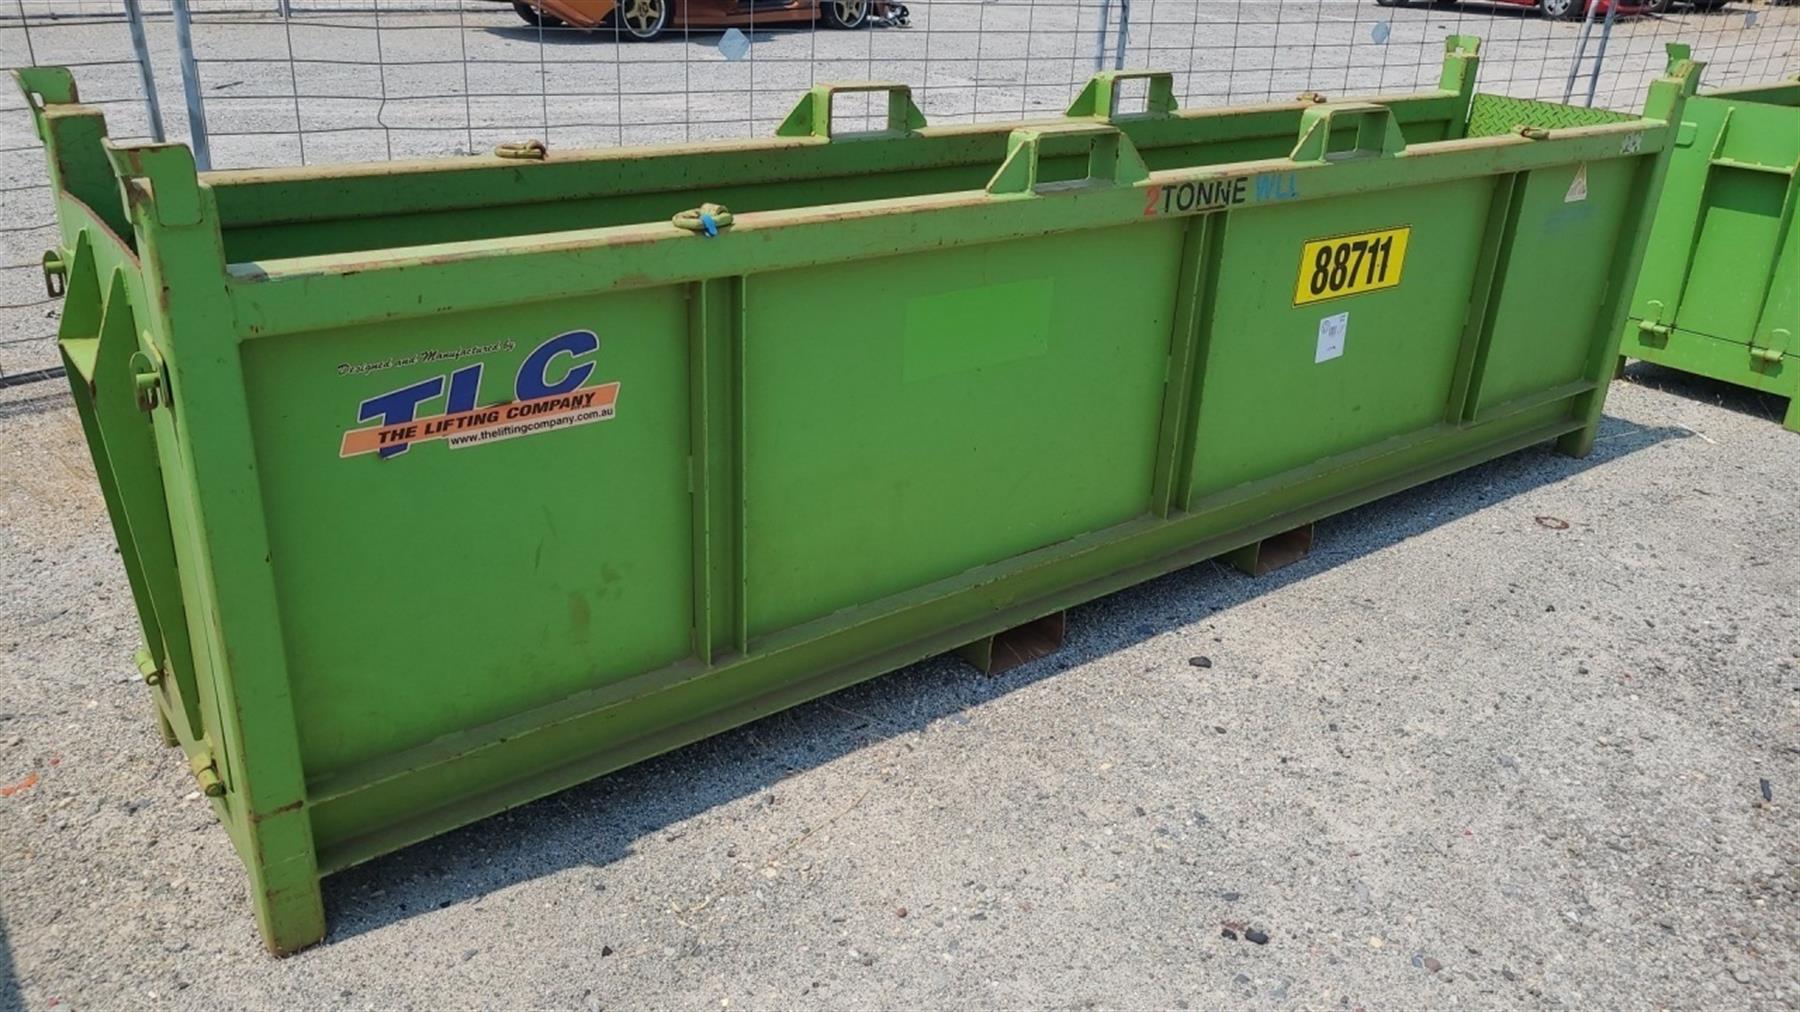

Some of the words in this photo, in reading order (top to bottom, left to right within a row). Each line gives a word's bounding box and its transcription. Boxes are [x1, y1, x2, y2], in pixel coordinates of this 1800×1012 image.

[1311, 235, 1393, 295] 88711
[337, 358, 393, 376] Designed
[395, 356, 417, 368] and
[421, 342, 501, 361] Manufactured
[358, 329, 599, 459] TLC
[378, 424, 417, 444] THE
[424, 411, 499, 436] LIFTING
[506, 392, 596, 419] COMPANY
[450, 406, 614, 447] www.theliftingcompany.com.au
